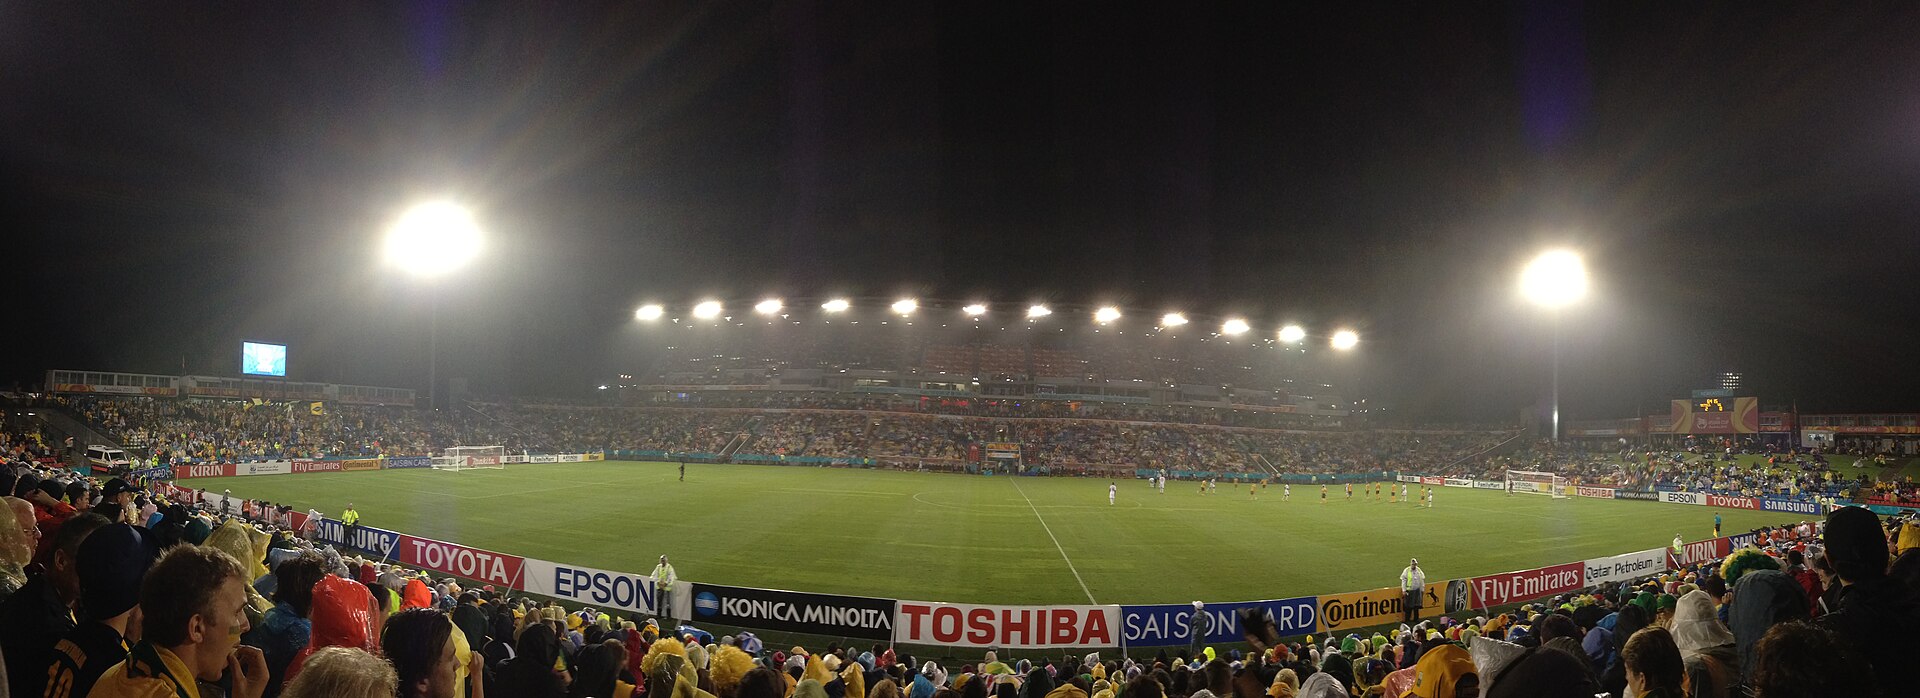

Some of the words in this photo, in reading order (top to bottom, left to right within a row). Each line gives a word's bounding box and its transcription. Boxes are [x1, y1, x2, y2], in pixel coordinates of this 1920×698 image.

[190, 465, 223, 477] KIRIN
[294, 462, 307, 473] Fly
[308, 461, 340, 471] Emirates
[1577, 487, 1613, 498] TOSHIBA
[1668, 493, 1697, 504] EPSON
[1712, 496, 1754, 509] TOYOTA
[1765, 501, 1815, 513] SAMSUNG
[412, 540, 509, 584] TOYOTA
[1682, 540, 1717, 565] KIRIN
[1586, 566, 1611, 583] Qatar
[1615, 558, 1653, 576] Petroleum
[555, 566, 655, 611] EPSON
[1481, 579, 1510, 603] Fly
[1512, 569, 1578, 598] Emirates
[721, 597, 801, 623] KONICA
[802, 604, 891, 630] MINOLTA
[901, 604, 1111, 645] TOSHIBA
[1265, 604, 1315, 631] ARD
[1320, 596, 1402, 628] Continen
